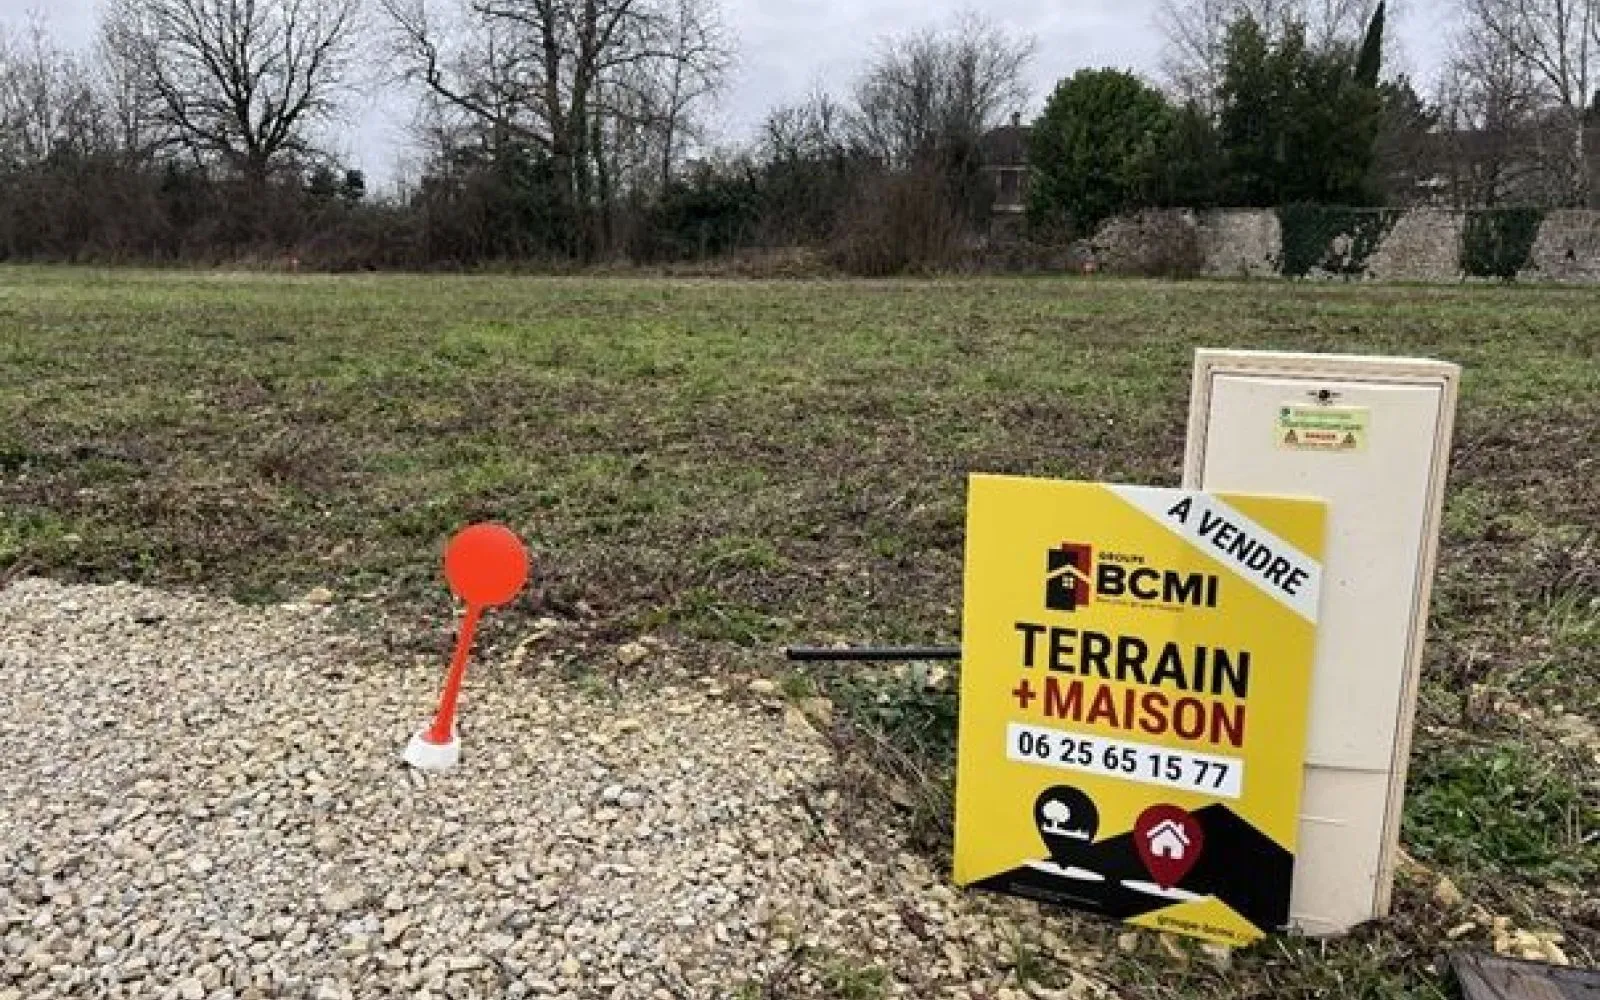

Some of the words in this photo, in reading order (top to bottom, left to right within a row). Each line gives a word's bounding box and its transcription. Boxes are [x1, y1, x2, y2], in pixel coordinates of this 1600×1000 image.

[1167, 495, 1193, 524] A
[1197, 508, 1309, 596] VENDRE
[1096, 564, 1218, 608] BCMI
[1014, 621, 1250, 698] TERRAIN
[1018, 731, 1050, 759] 06
[1059, 737, 1095, 766] 25
[1101, 745, 1137, 774] 65
[1149, 754, 1182, 782] 15
[1191, 760, 1229, 789] 77
